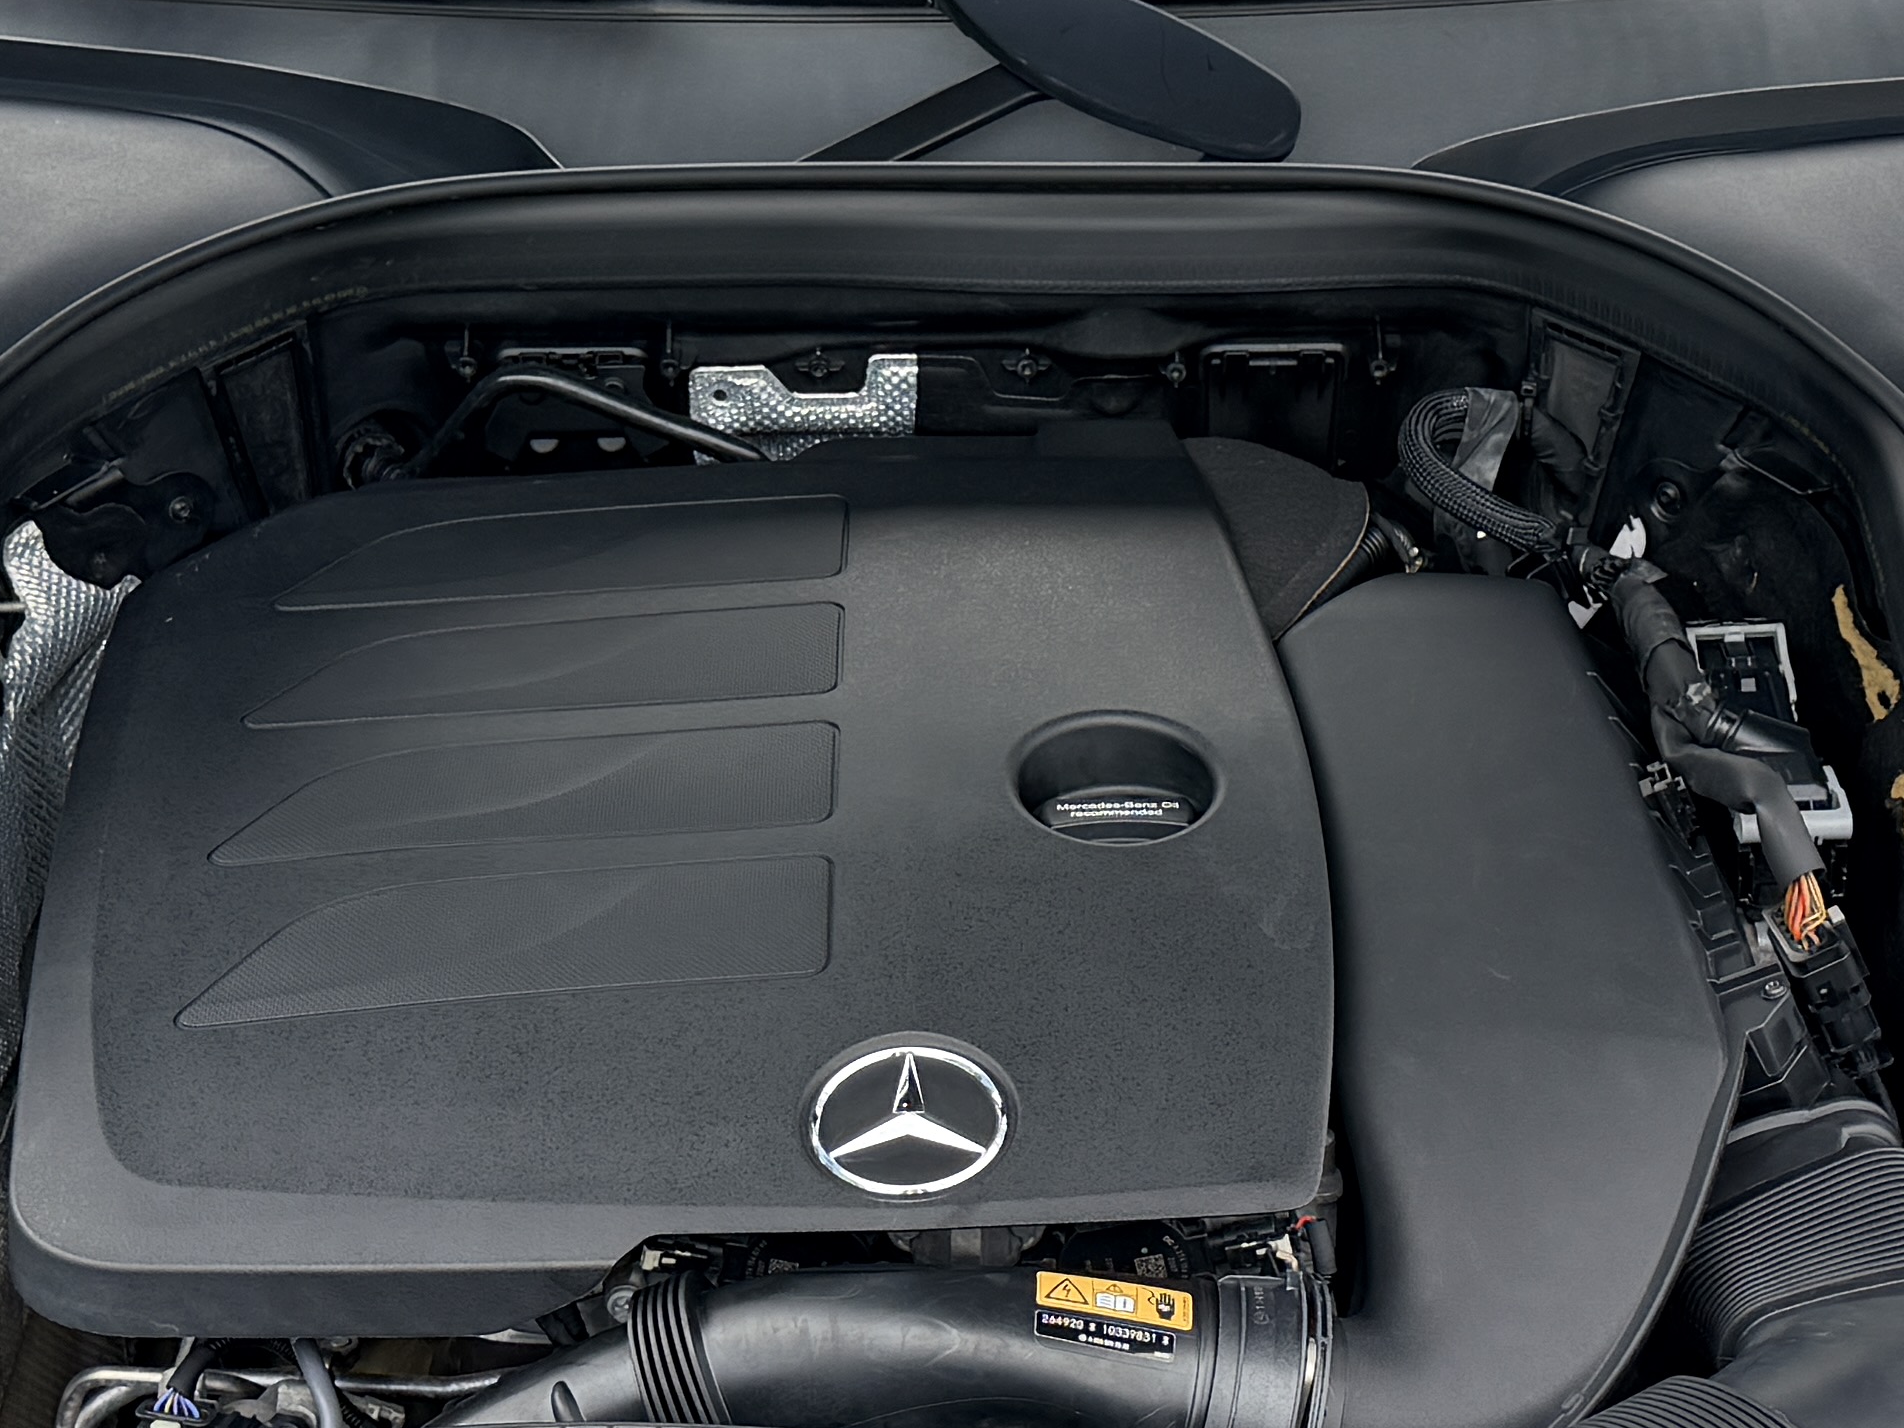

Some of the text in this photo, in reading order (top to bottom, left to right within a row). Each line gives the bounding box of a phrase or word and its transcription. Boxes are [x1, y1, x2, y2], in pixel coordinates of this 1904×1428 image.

[1056, 801, 1179, 811] Mercedes-Benz Oil
[1070, 808, 1163, 817] recommended
[1041, 1313, 1085, 1331] 264920
